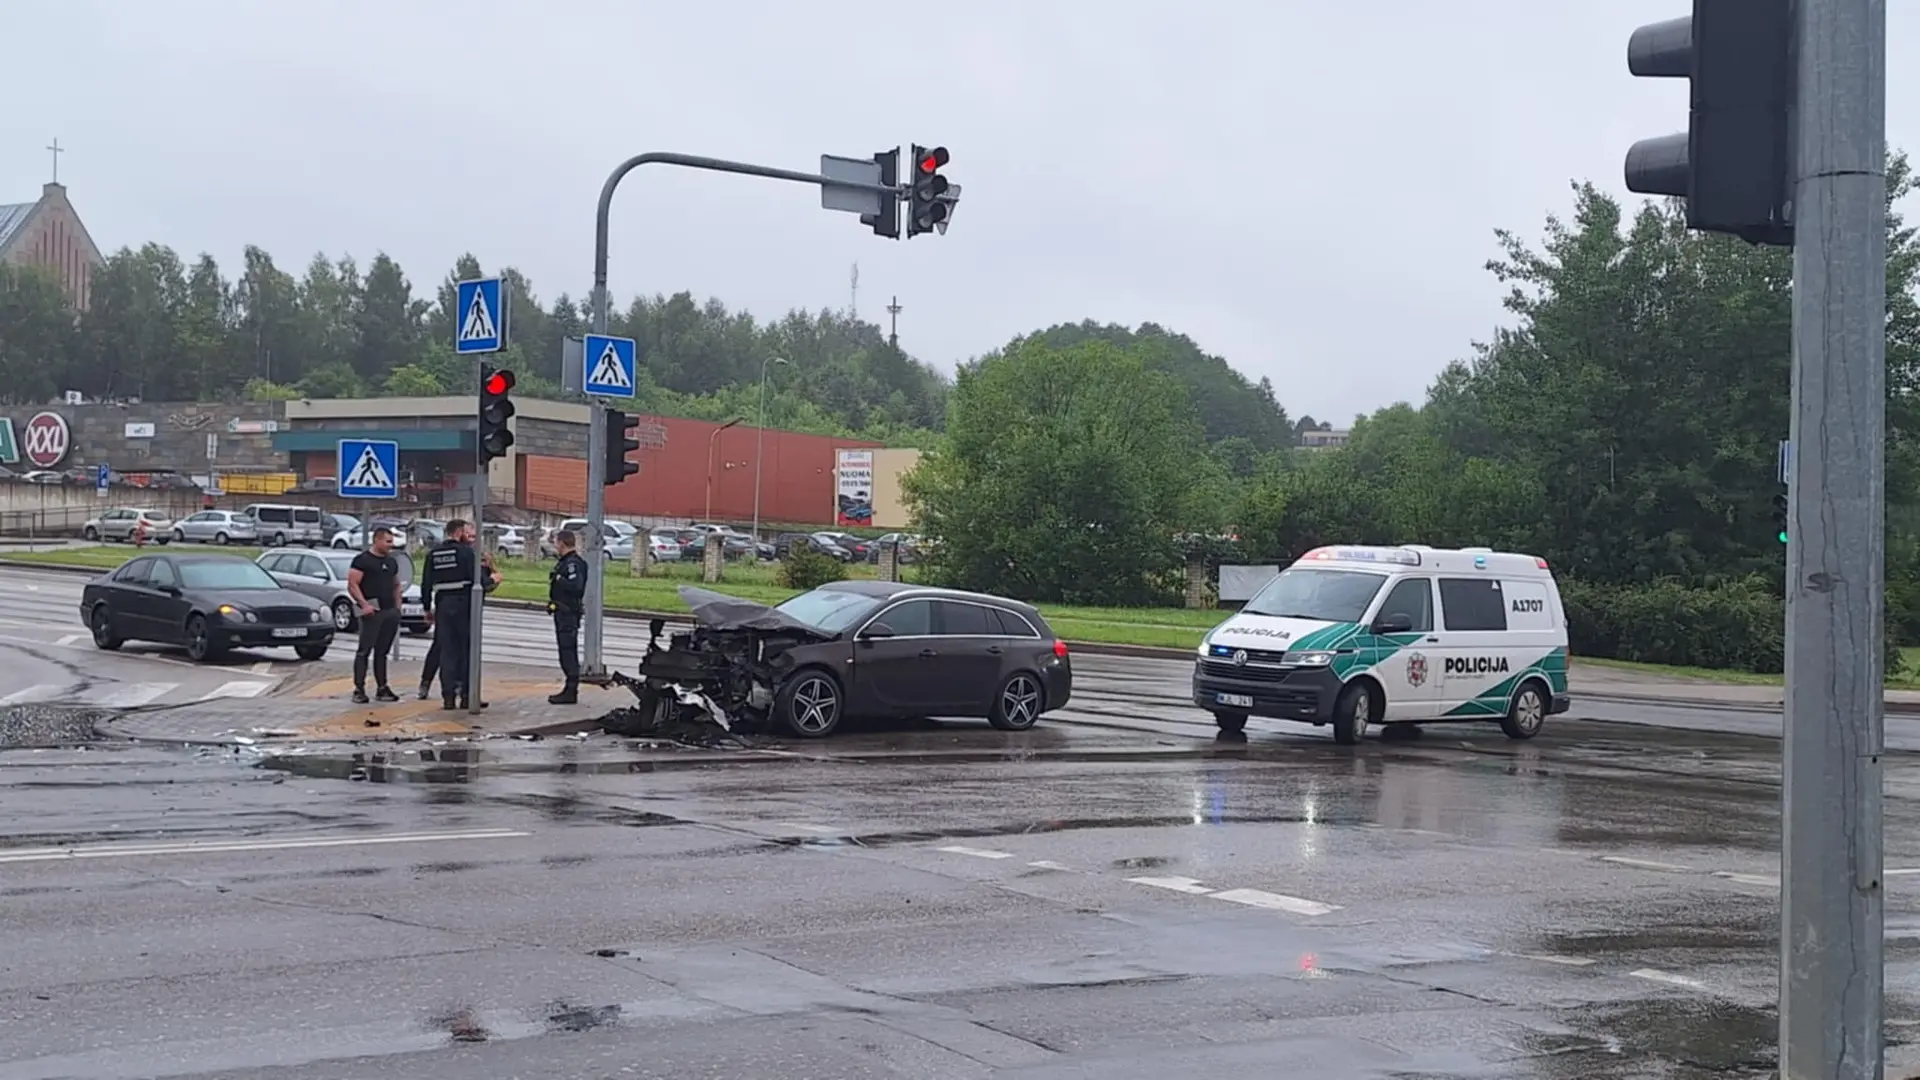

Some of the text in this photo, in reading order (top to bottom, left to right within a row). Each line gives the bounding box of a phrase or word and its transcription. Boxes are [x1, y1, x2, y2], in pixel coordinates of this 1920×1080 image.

[28, 425, 64, 453] XXL
[840, 470, 871, 478] NUOMA
[1512, 599, 1543, 613] A1707
[1223, 627, 1291, 640] POLICIJA
[1445, 656, 1509, 673] POLICIJA
